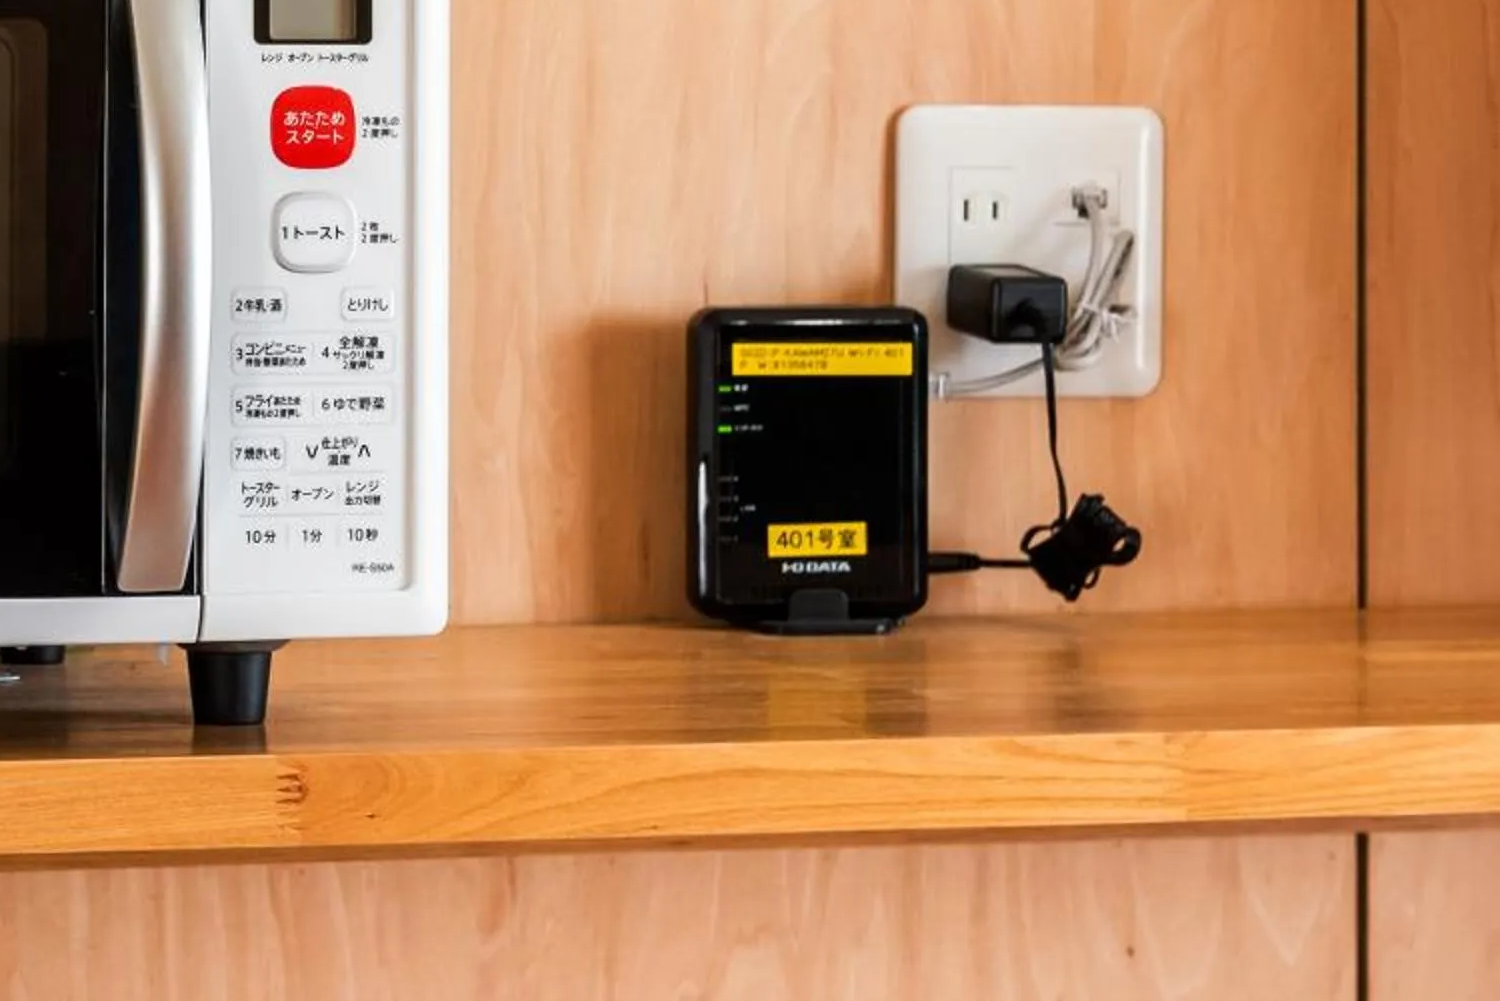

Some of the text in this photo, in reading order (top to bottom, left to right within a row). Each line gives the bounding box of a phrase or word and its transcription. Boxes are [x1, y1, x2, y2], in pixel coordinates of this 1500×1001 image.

[283, 110, 346, 127] あたため
[286, 129, 345, 144] スタート
[347, 298, 389, 311] とりけし
[346, 481, 379, 493] レンジ
[245, 530, 276, 544] 10分
[302, 530, 323, 542] 1分
[348, 528, 379, 542] 10秒
[776, 528, 857, 549] 401号室
